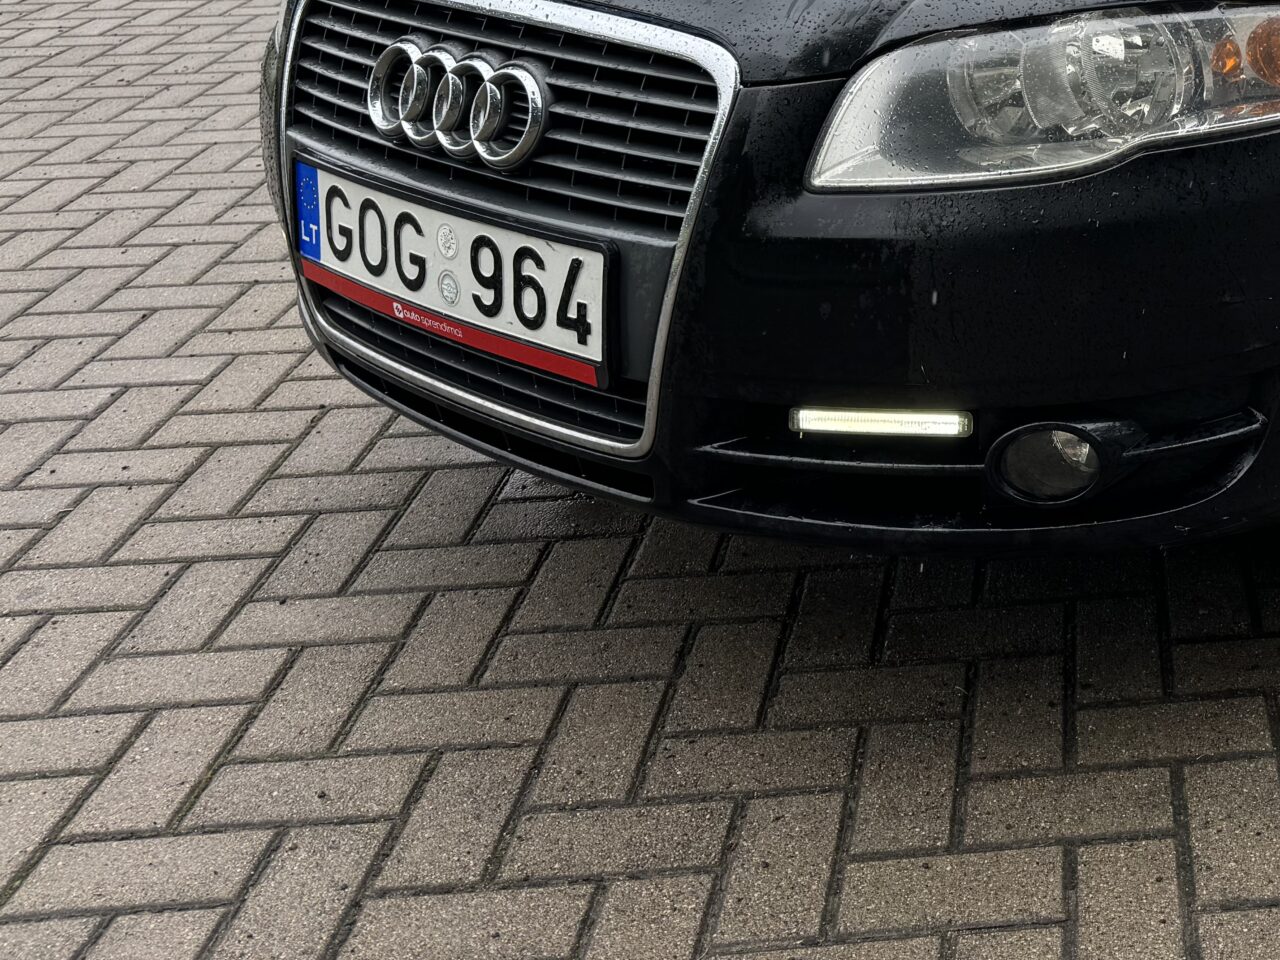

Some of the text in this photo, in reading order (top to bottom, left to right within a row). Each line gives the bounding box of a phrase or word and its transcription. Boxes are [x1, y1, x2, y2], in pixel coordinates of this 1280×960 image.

[301, 220, 318, 245] LT
[325, 185, 592, 346] GOG 964
